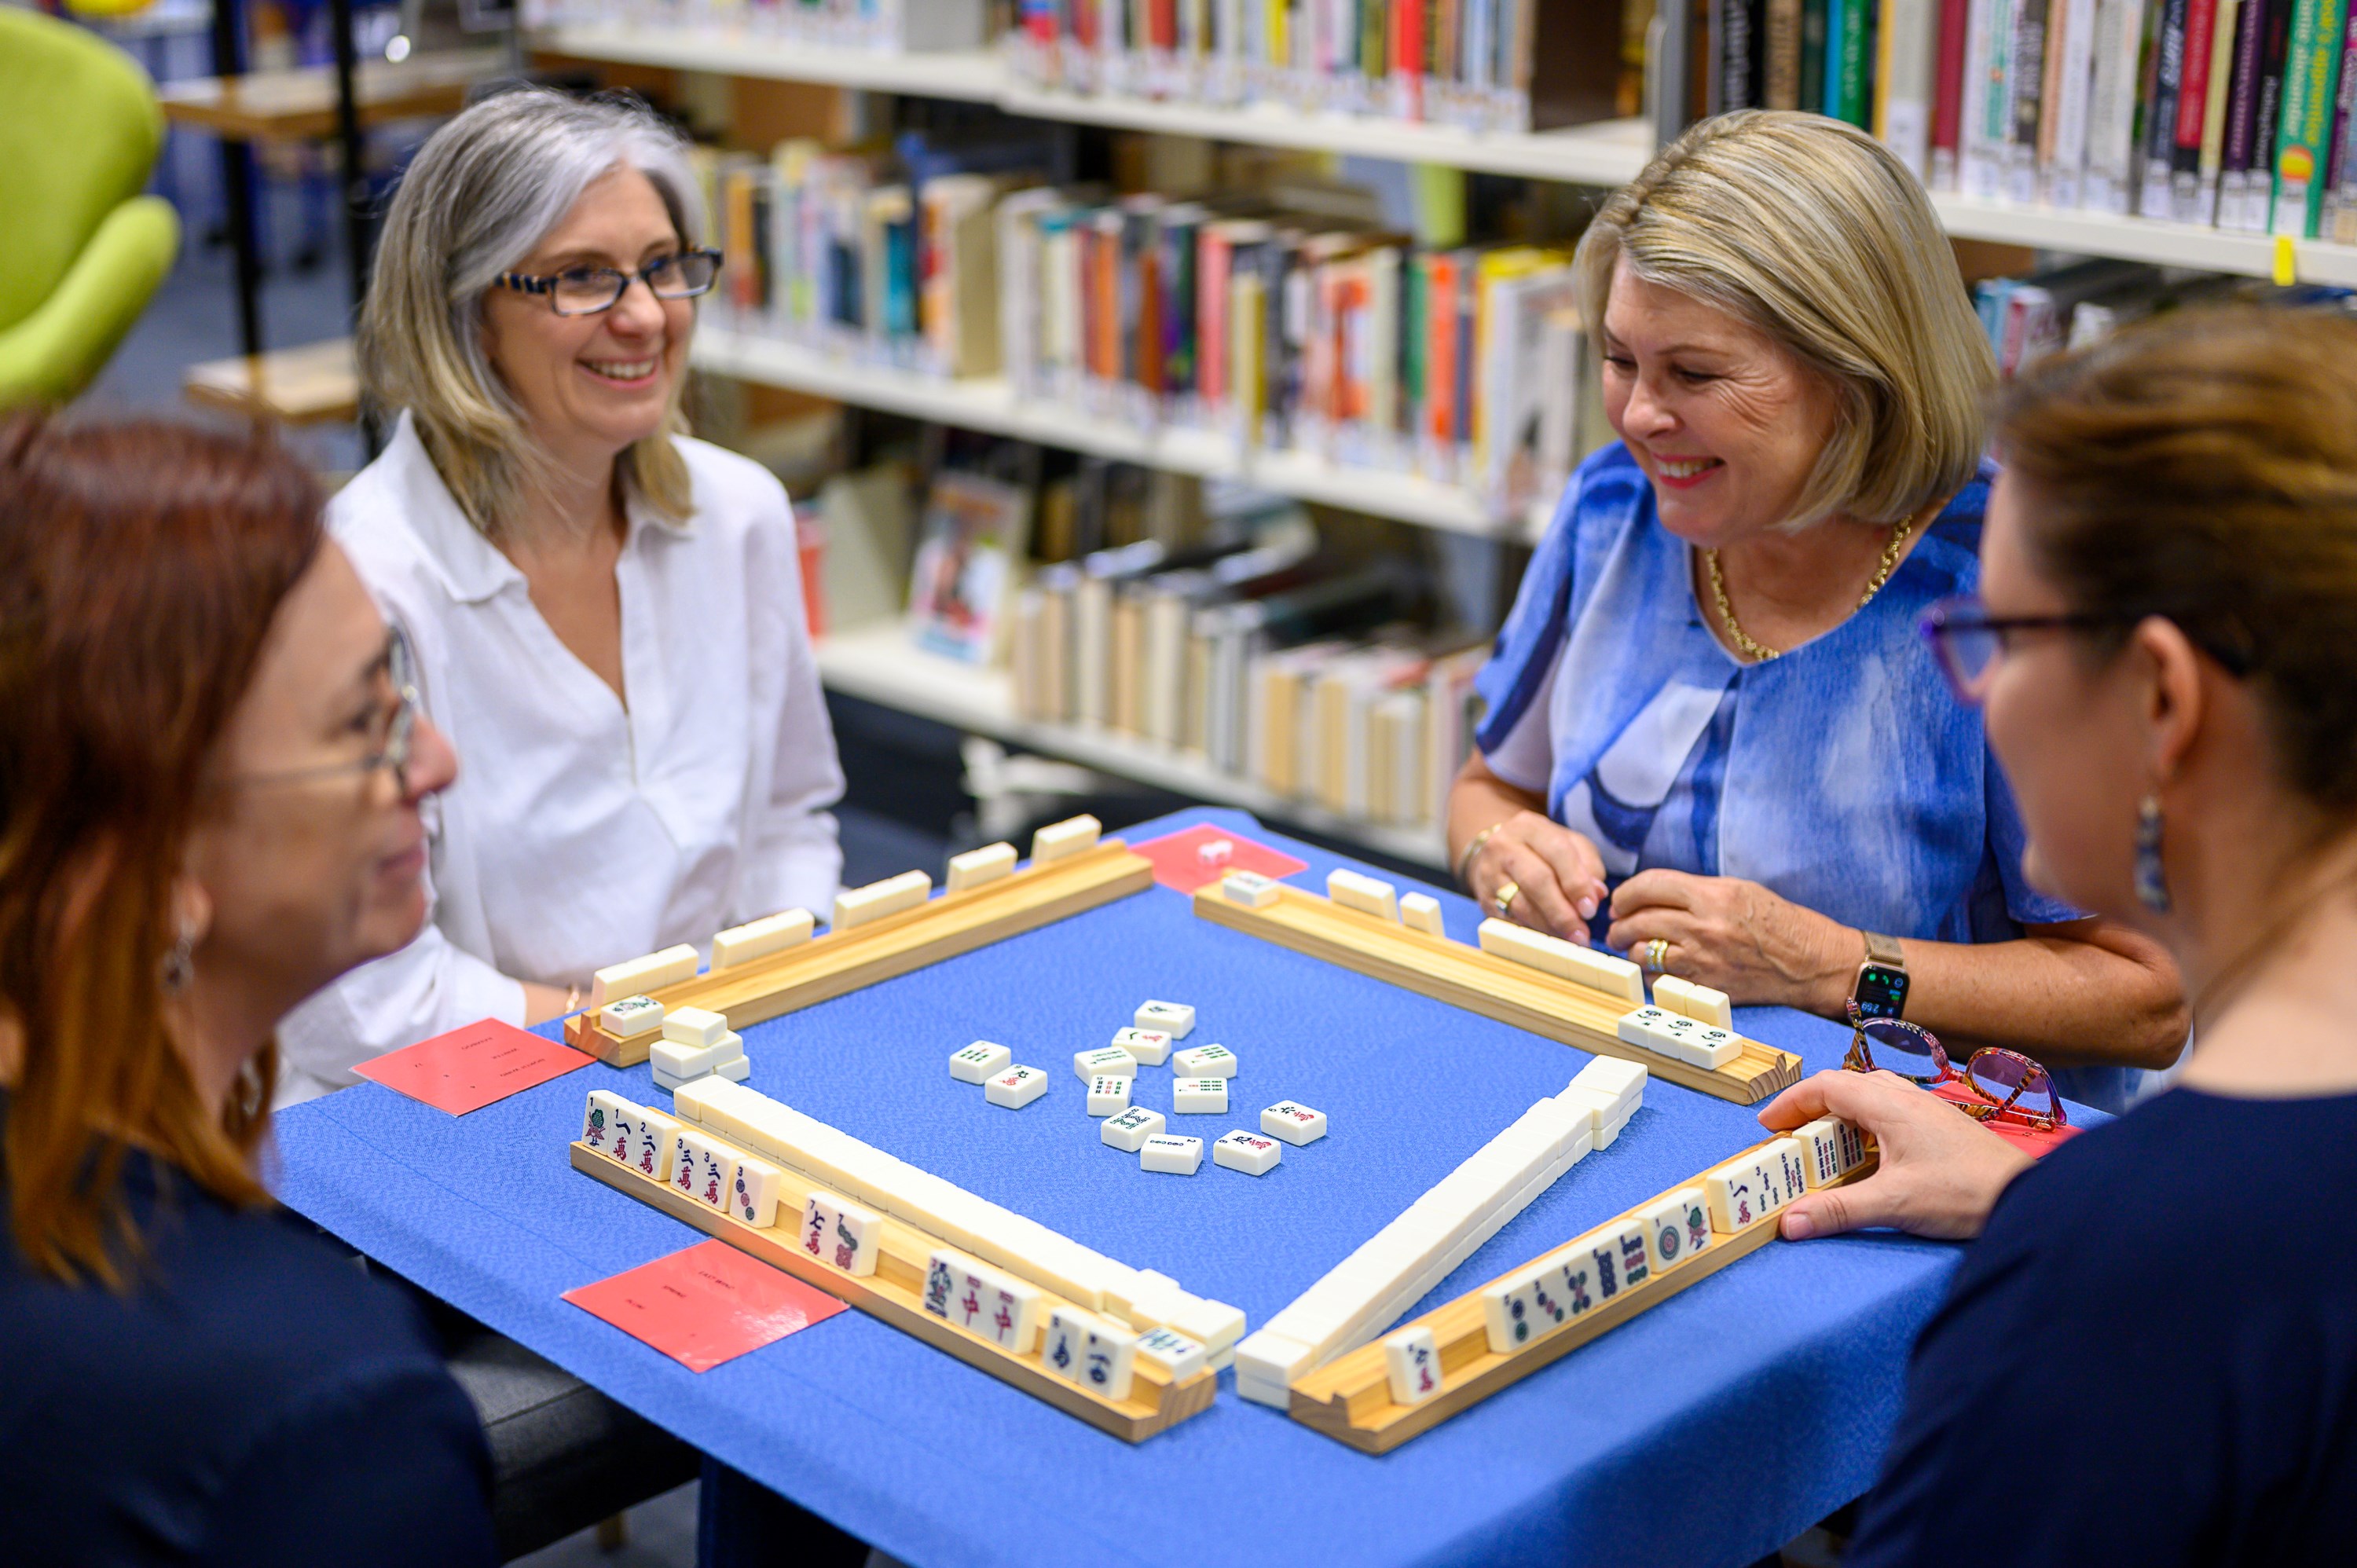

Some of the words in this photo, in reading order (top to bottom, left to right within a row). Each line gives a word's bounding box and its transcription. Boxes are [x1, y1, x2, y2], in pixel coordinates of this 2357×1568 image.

[589, 1097, 594, 1107] 1
[615, 1108, 619, 1119] 1
[640, 1122, 646, 1132] 2
[1839, 1123, 1845, 1134] 9
[677, 1139, 684, 1149] 3
[1815, 1136, 1820, 1147] 9
[704, 1152, 710, 1163] 3
[1781, 1152, 1787, 1163] 5
[737, 1167, 743, 1177] 3
[1755, 1166, 1761, 1177] 3
[1729, 1180, 1734, 1190] 1
[810, 1199, 816, 1210] 7
[838, 1213, 845, 1224] 7
